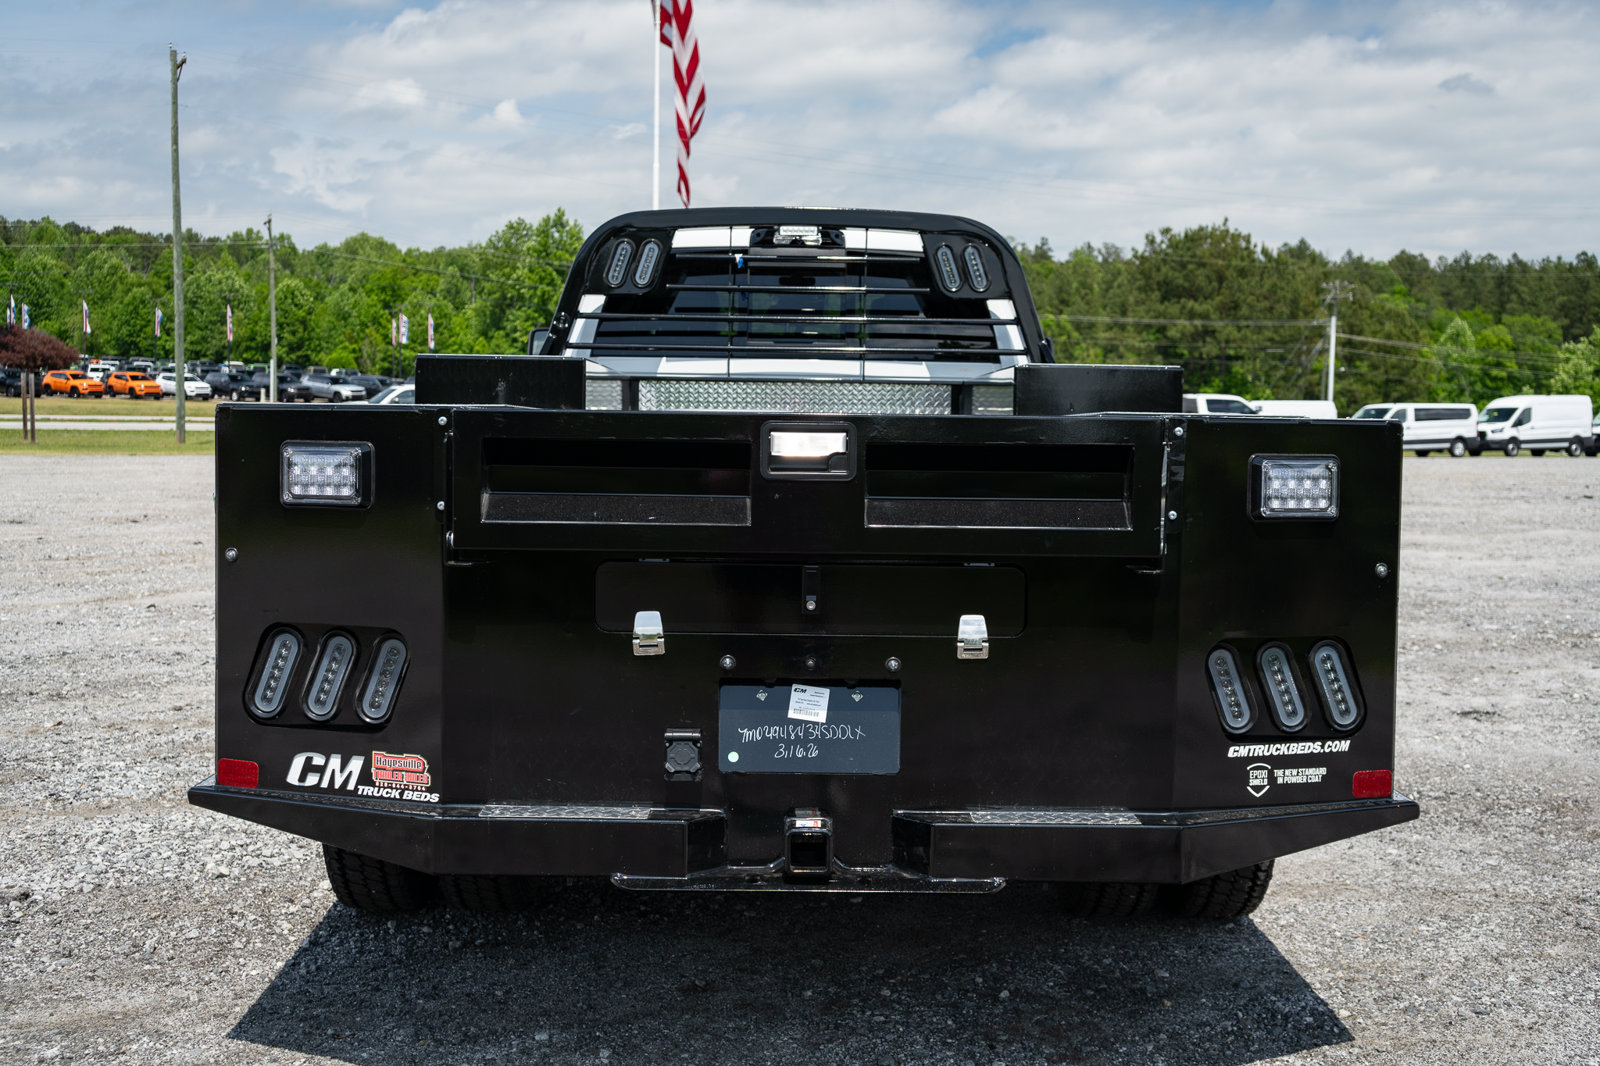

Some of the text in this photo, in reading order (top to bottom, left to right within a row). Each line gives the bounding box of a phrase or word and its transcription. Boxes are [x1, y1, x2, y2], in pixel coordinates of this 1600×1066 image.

[1227, 740, 1351, 758] CMTRUCKBEDS.COM
[376, 756, 422, 770] Hayesville
[286, 752, 365, 791] CM
[1249, 770, 1268, 779] EPOXI
[1273, 767, 1327, 777] THE NEW STANDARD
[1249, 778, 1268, 786] SHIELD
[1277, 774, 1323, 784] IN POWDER COAT
[357, 785, 440, 803] TRUCK BEDS
